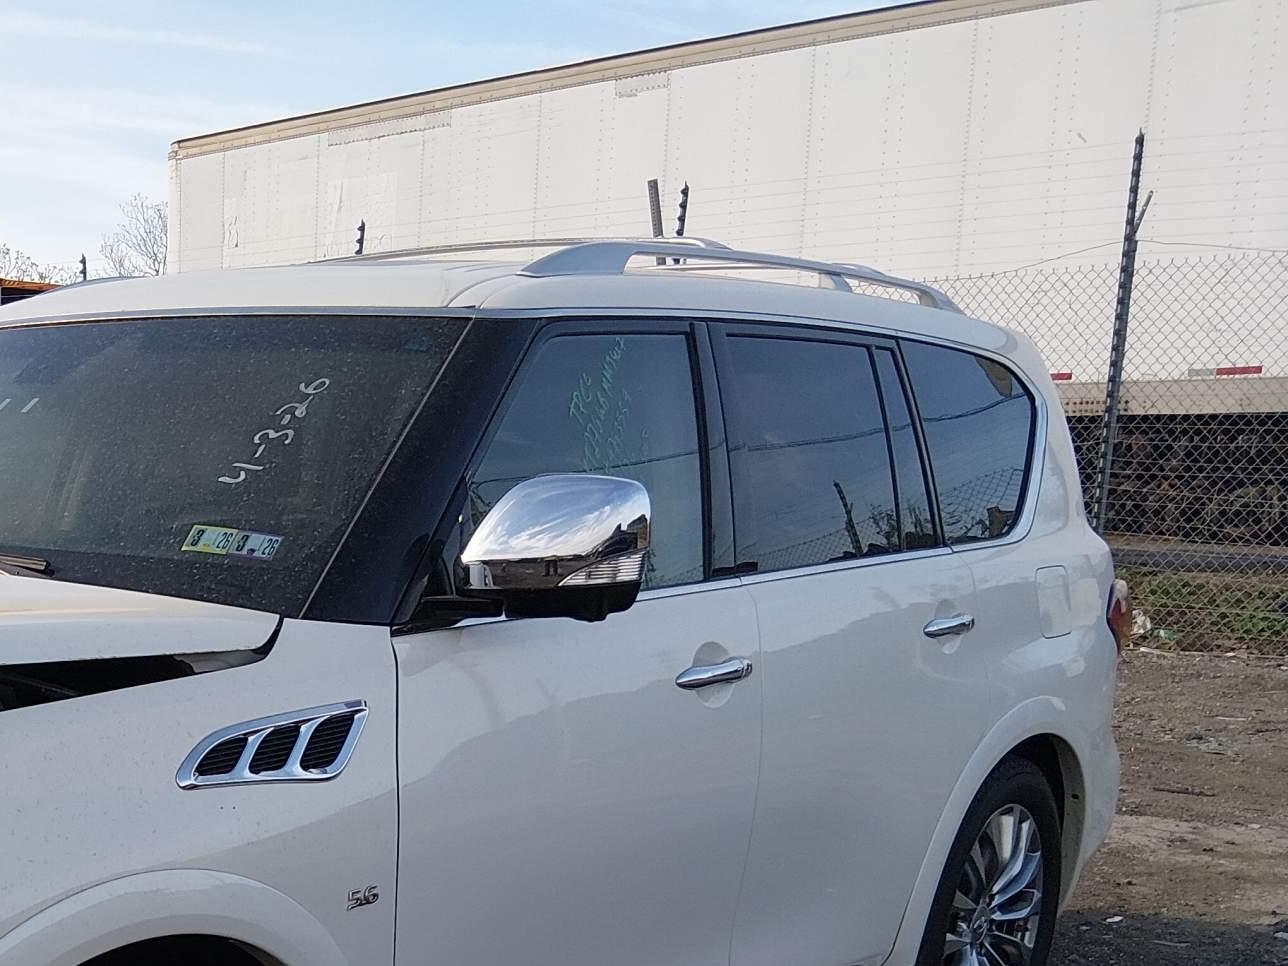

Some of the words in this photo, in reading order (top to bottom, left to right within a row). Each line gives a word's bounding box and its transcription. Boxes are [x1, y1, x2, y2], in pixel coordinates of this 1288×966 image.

[190, 529, 205, 547] 3
[215, 531, 234, 550] 26
[236, 534, 250, 552] 3
[261, 538, 280, 556] 26
